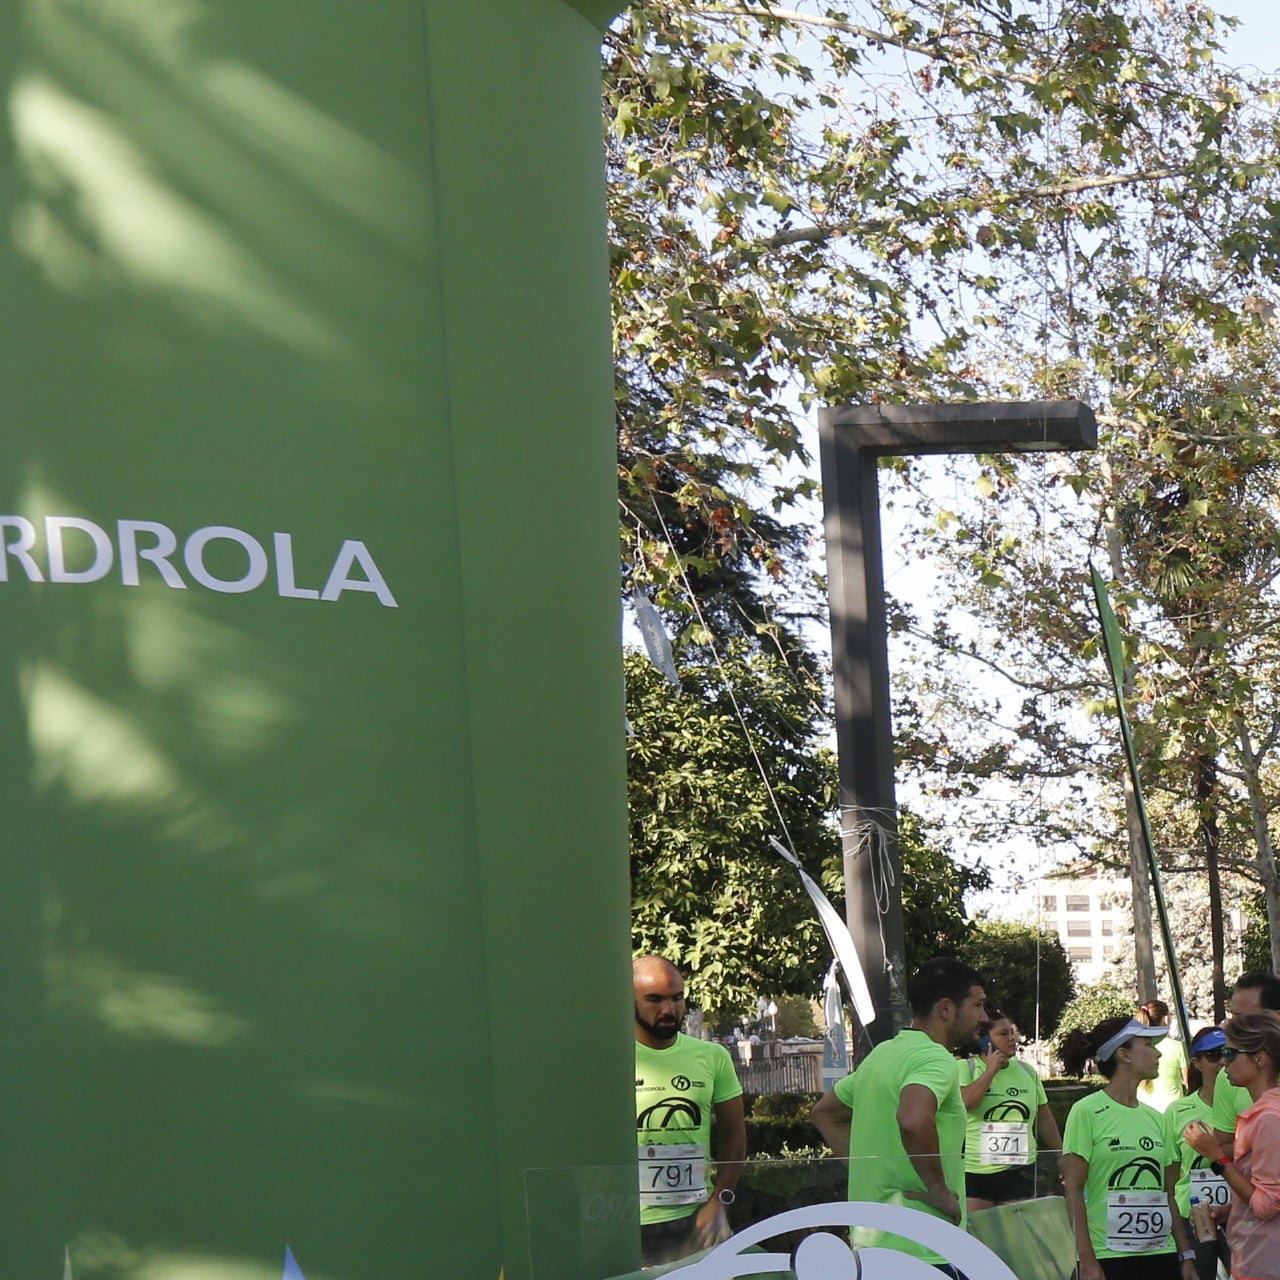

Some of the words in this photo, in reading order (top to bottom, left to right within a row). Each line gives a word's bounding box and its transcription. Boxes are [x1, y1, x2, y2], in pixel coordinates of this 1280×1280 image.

[988, 1136, 1019, 1152] 371
[648, 1164, 693, 1188] 791
[1117, 1211, 1164, 1235] 259
